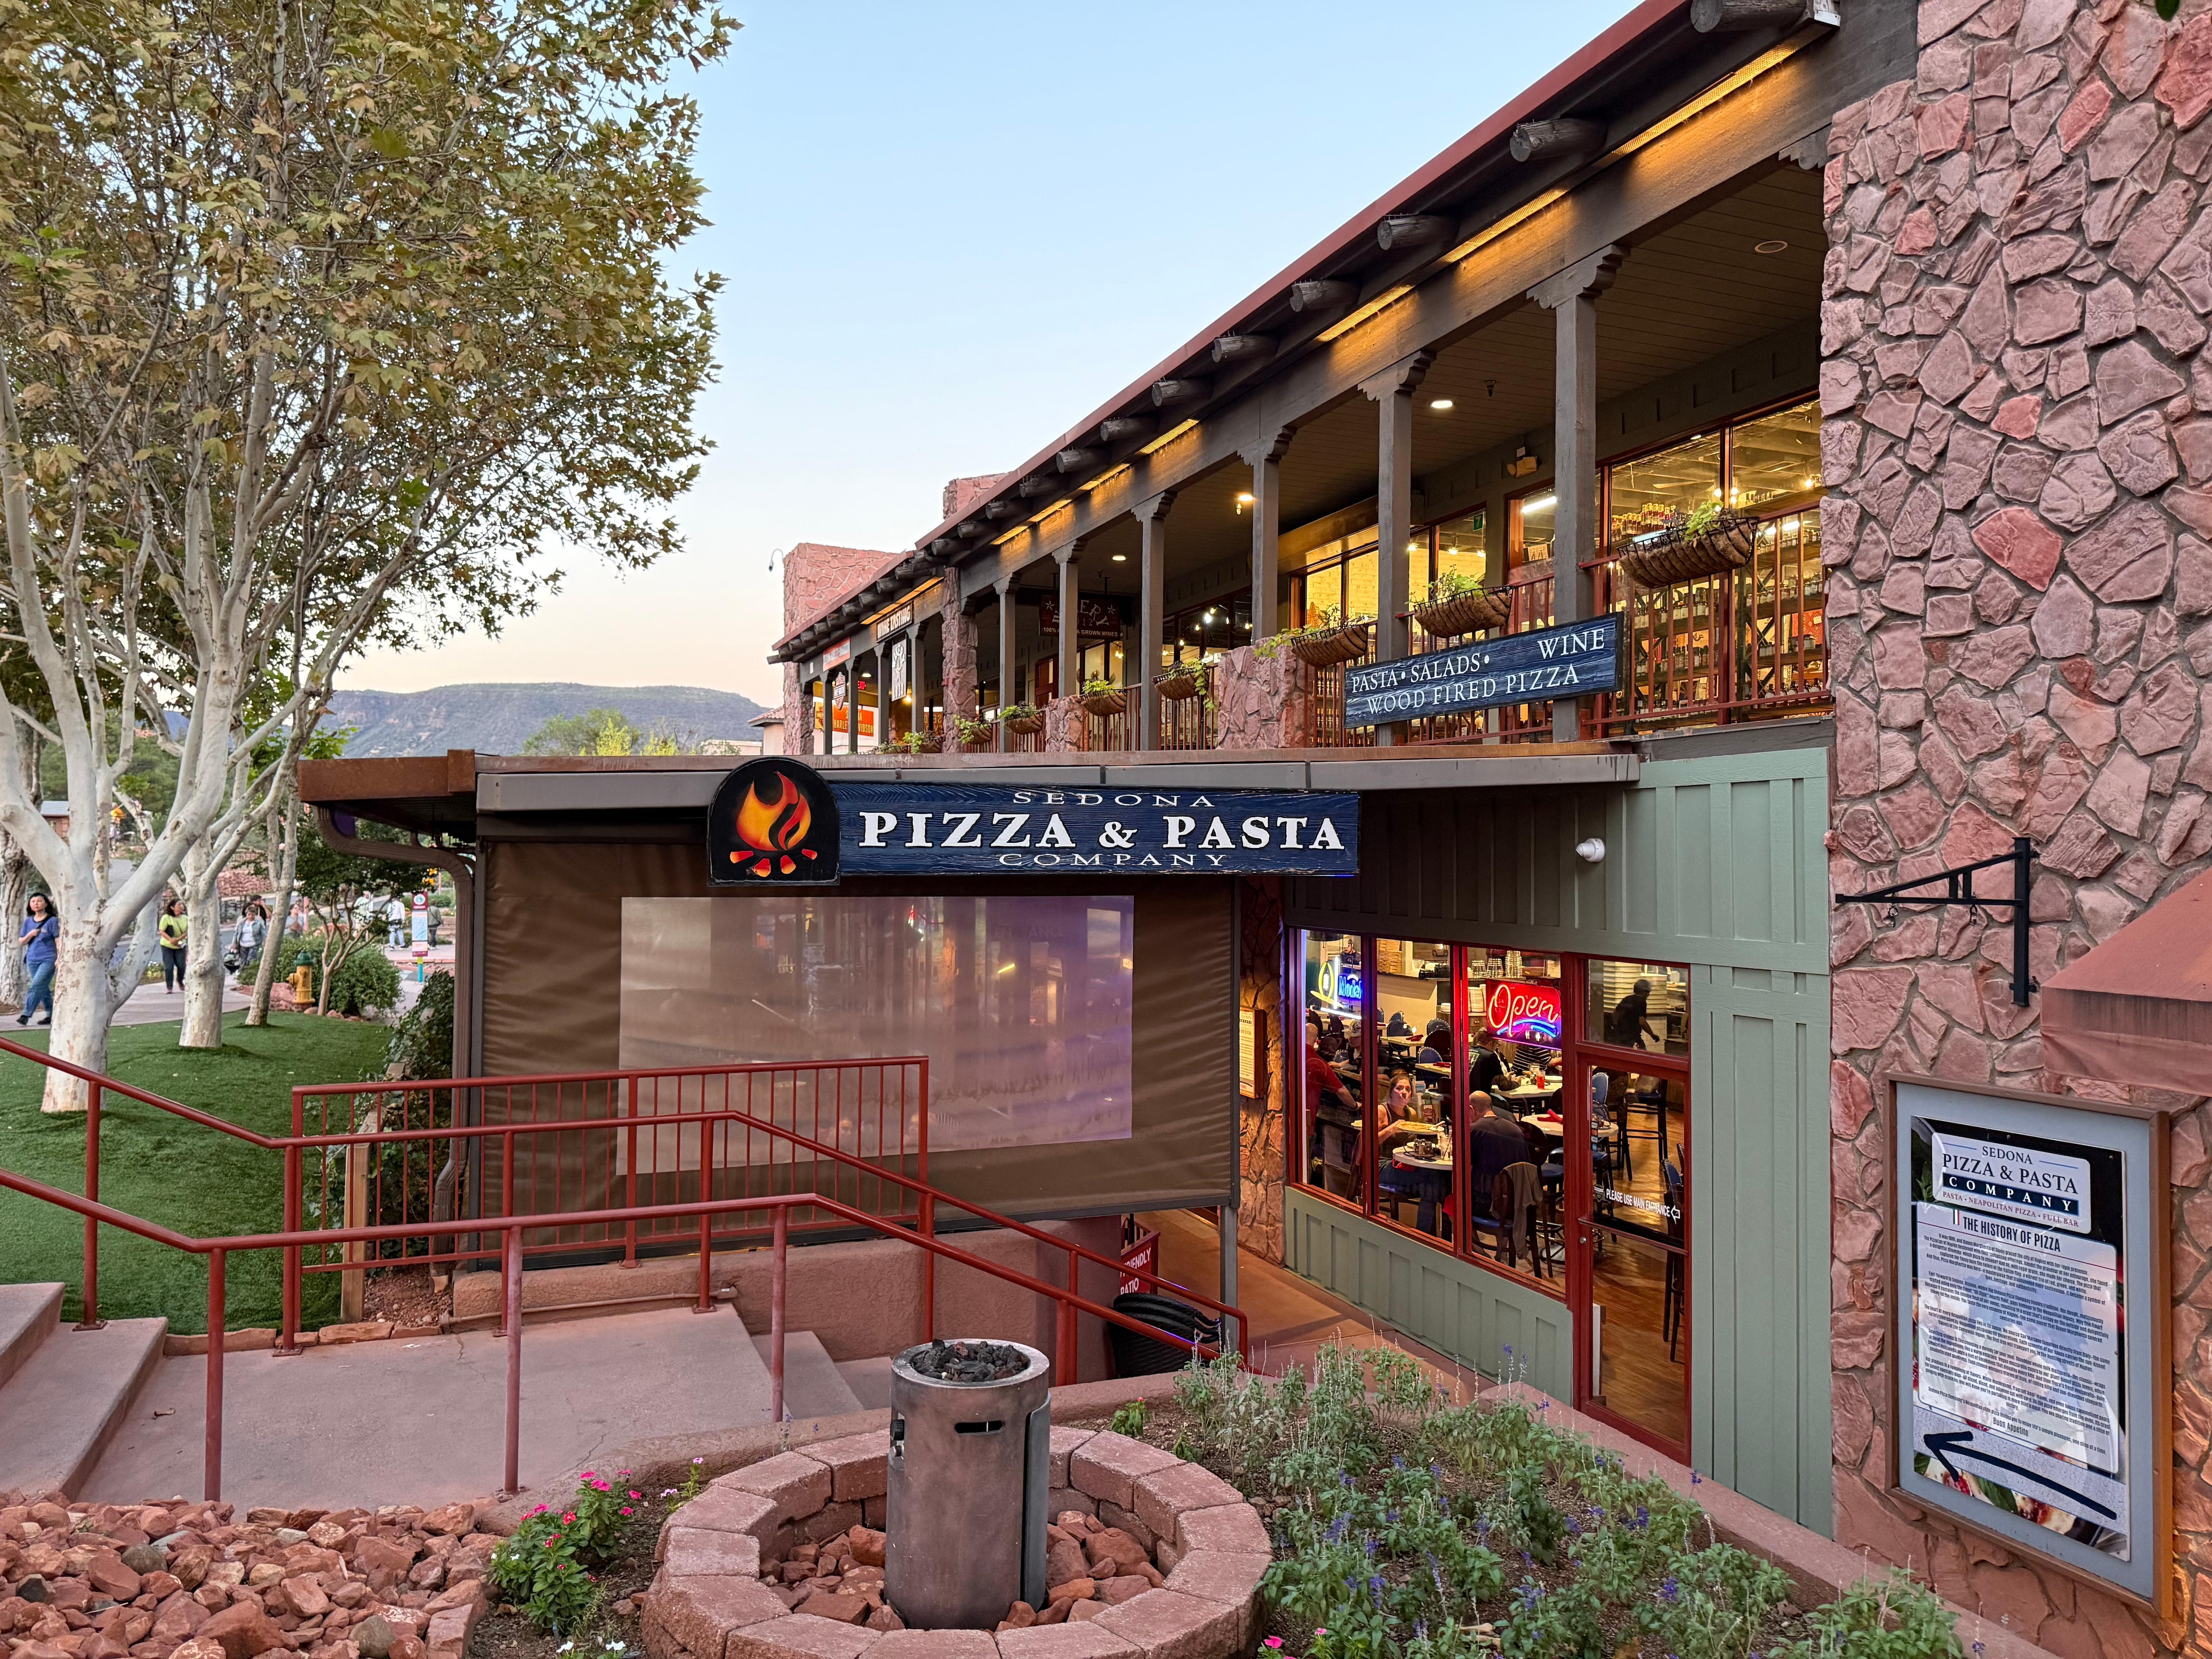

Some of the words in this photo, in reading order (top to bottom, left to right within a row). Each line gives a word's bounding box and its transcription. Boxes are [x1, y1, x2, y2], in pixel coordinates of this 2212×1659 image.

[877, 621, 890, 639] WINE
[890, 605, 910, 632] TASTING
[1352, 669, 1398, 693] PASTA
[1411, 653, 1480, 682] SALADS
[1537, 628, 1605, 659] WINE
[1367, 691, 1425, 714] WOOD
[1432, 678, 1496, 705] FIRED
[1505, 664, 1579, 694] PIZZA
[1013, 792, 1215, 807] SEDONA
[859, 811, 1076, 847] PIZZA
[1098, 821, 1137, 849] &
[1163, 815, 1345, 850] PASTA
[998, 853, 1227, 866] COMPANY
[1339, 975, 1362, 999] Model
[1488, 984, 1559, 1038] Open
[1982, 1145, 2033, 1165] SEDONA
[1942, 1153, 1994, 1177] PIZZA
[2000, 1165, 2014, 1181] &
[2019, 1168, 2079, 1194] PASTA
[1606, 1188, 1623, 1204] PLEASE
[1624, 1194, 1632, 1206] USE
[1633, 1197, 1645, 1210] MAIN
[1646, 1200, 1671, 1217] ENTRANCE
[1943, 1191, 1963, 1201] PASTA
[1968, 1197, 2013, 1213] NEAPOLITAN
[2015, 1205, 2036, 1217] PIZZA
[2043, 1213, 2062, 1224] FULL
[2063, 1217, 2079, 1227] BAR
[1949, 1176, 2072, 1211] COMPANY
[1963, 1216, 1978, 1233] THE
[1981, 1221, 2017, 1242] HISTORY
[2020, 1229, 2032, 1245] OF
[2034, 1233, 2061, 1252] PIZZA
[1120, 1277, 1139, 1295] PATIO
[1993, 1417, 2005, 1428] Buon
[2007, 1422, 2028, 1437] Appetito
